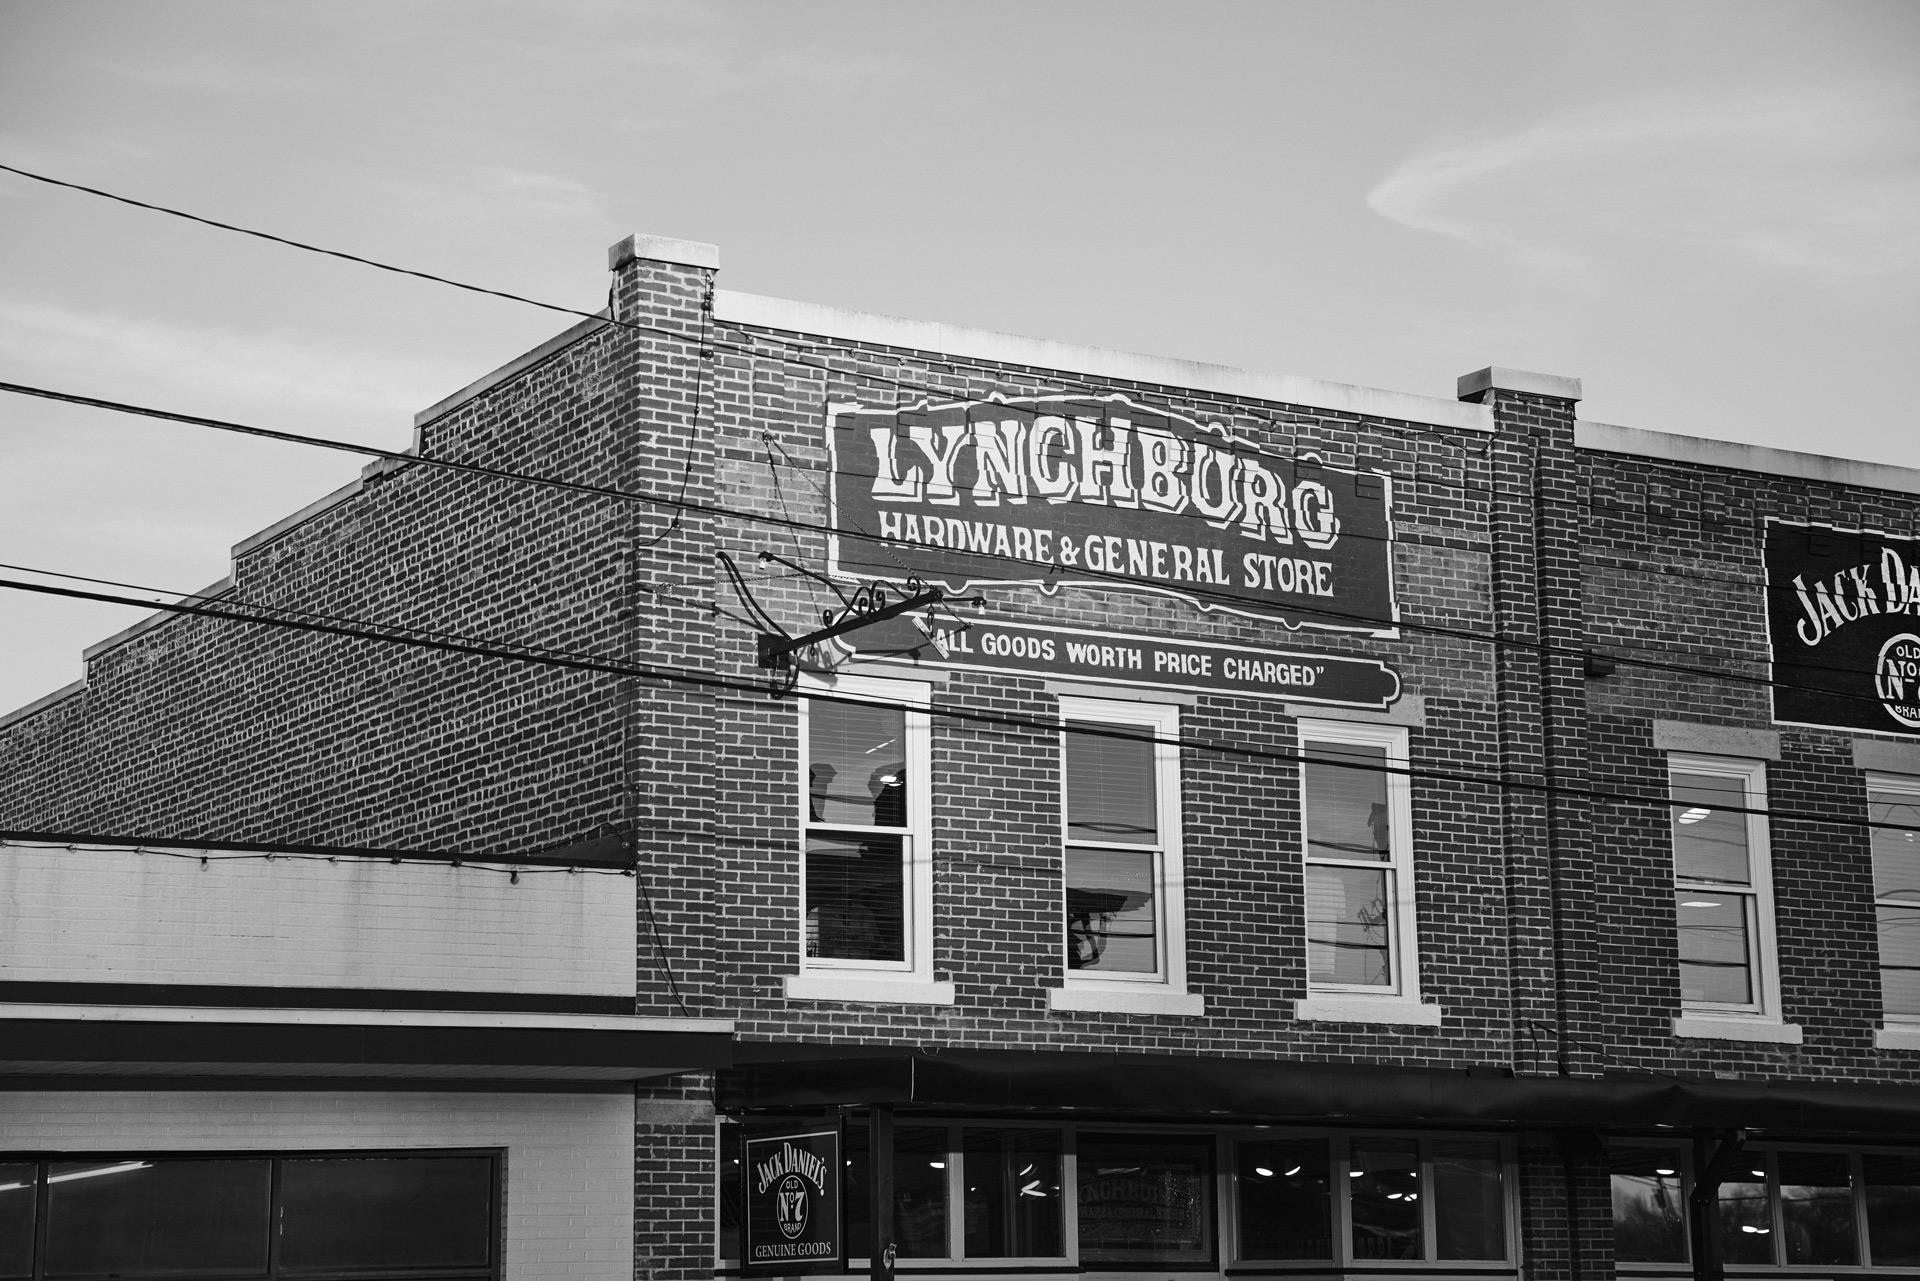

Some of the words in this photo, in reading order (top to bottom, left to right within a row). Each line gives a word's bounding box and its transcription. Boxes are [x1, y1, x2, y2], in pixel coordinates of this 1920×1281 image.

[870, 415, 1341, 550] LYNCHBURG
[878, 510, 1054, 564] HARDWARE
[1060, 536, 1080, 565] &
[1084, 534, 1230, 586] GENERAL
[1243, 551, 1335, 597] STORE
[1792, 564, 1881, 646] JACK
[981, 631, 1056, 661] GOODS
[1066, 642, 1142, 670] WORTH
[1154, 651, 1212, 677] PRICE
[756, 1151, 784, 1194] JACK
[786, 1180, 798, 1189] OLD
[755, 1244, 796, 1258] GENUINE
[798, 1242, 831, 1256] GOODS
[783, 1223, 802, 1233] BRAND
